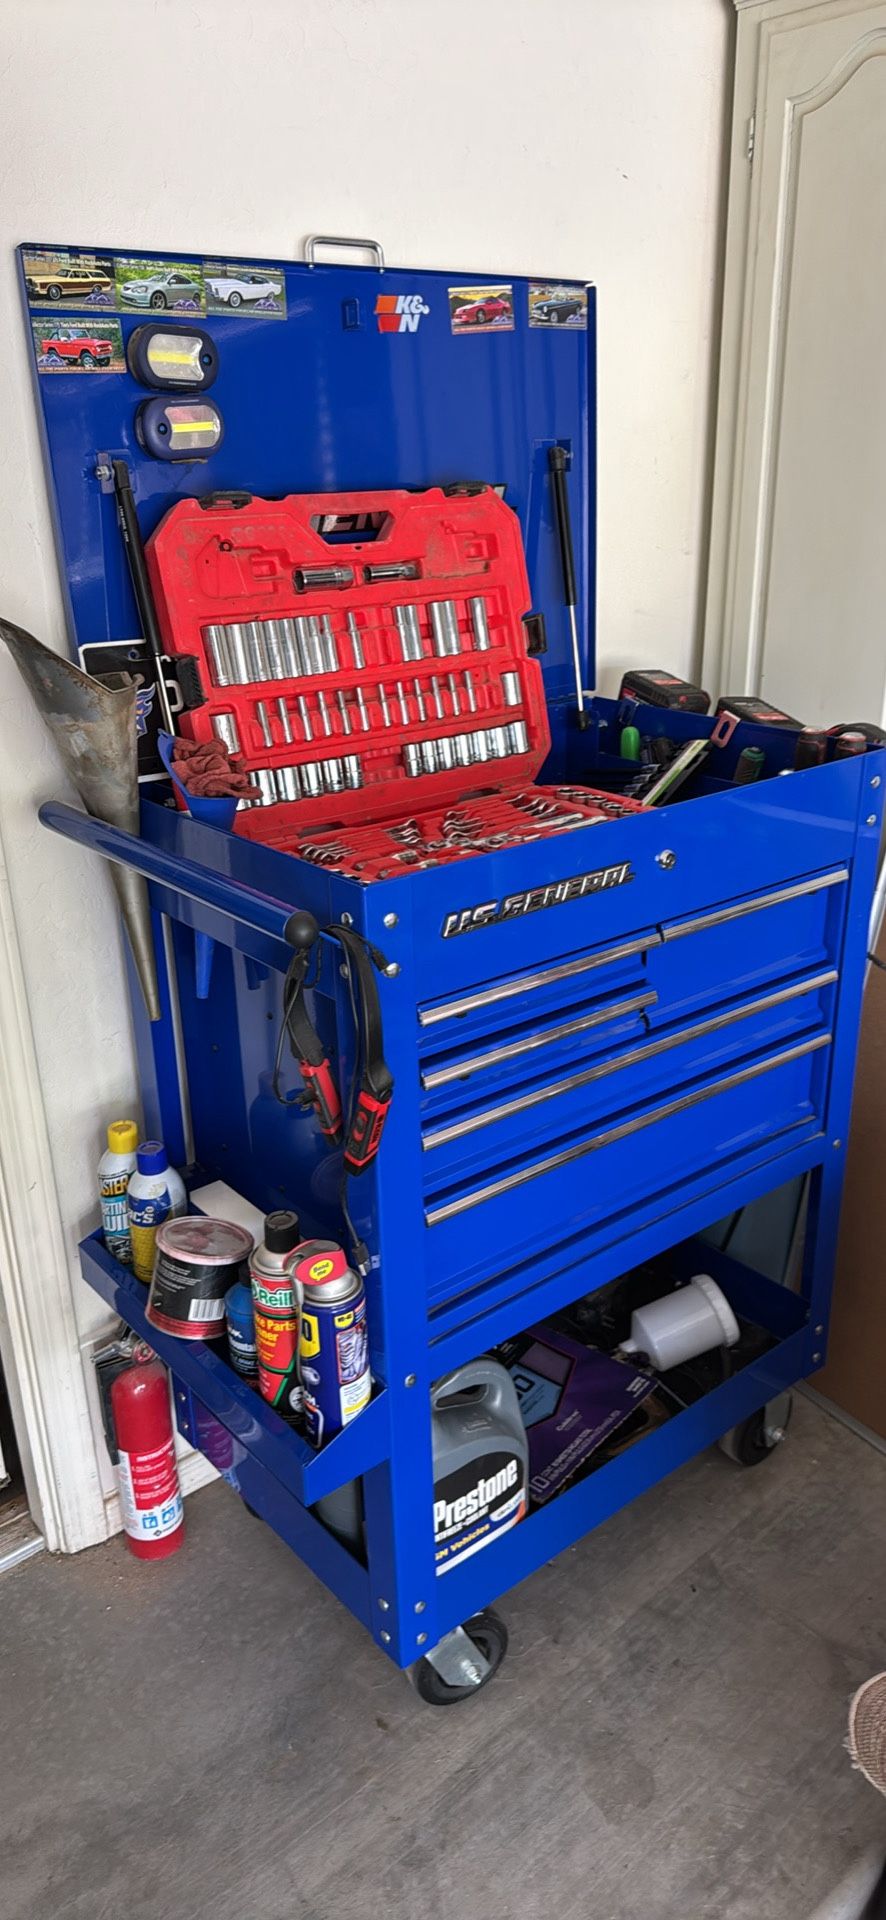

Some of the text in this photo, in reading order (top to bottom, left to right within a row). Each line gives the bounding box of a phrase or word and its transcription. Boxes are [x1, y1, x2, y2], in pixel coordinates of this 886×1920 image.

[501, 861, 636, 920] GENERAL
[100, 1174, 129, 1197] STER
[267, 1319, 297, 1332] Parts
[433, 1459, 518, 1534] Prestone
